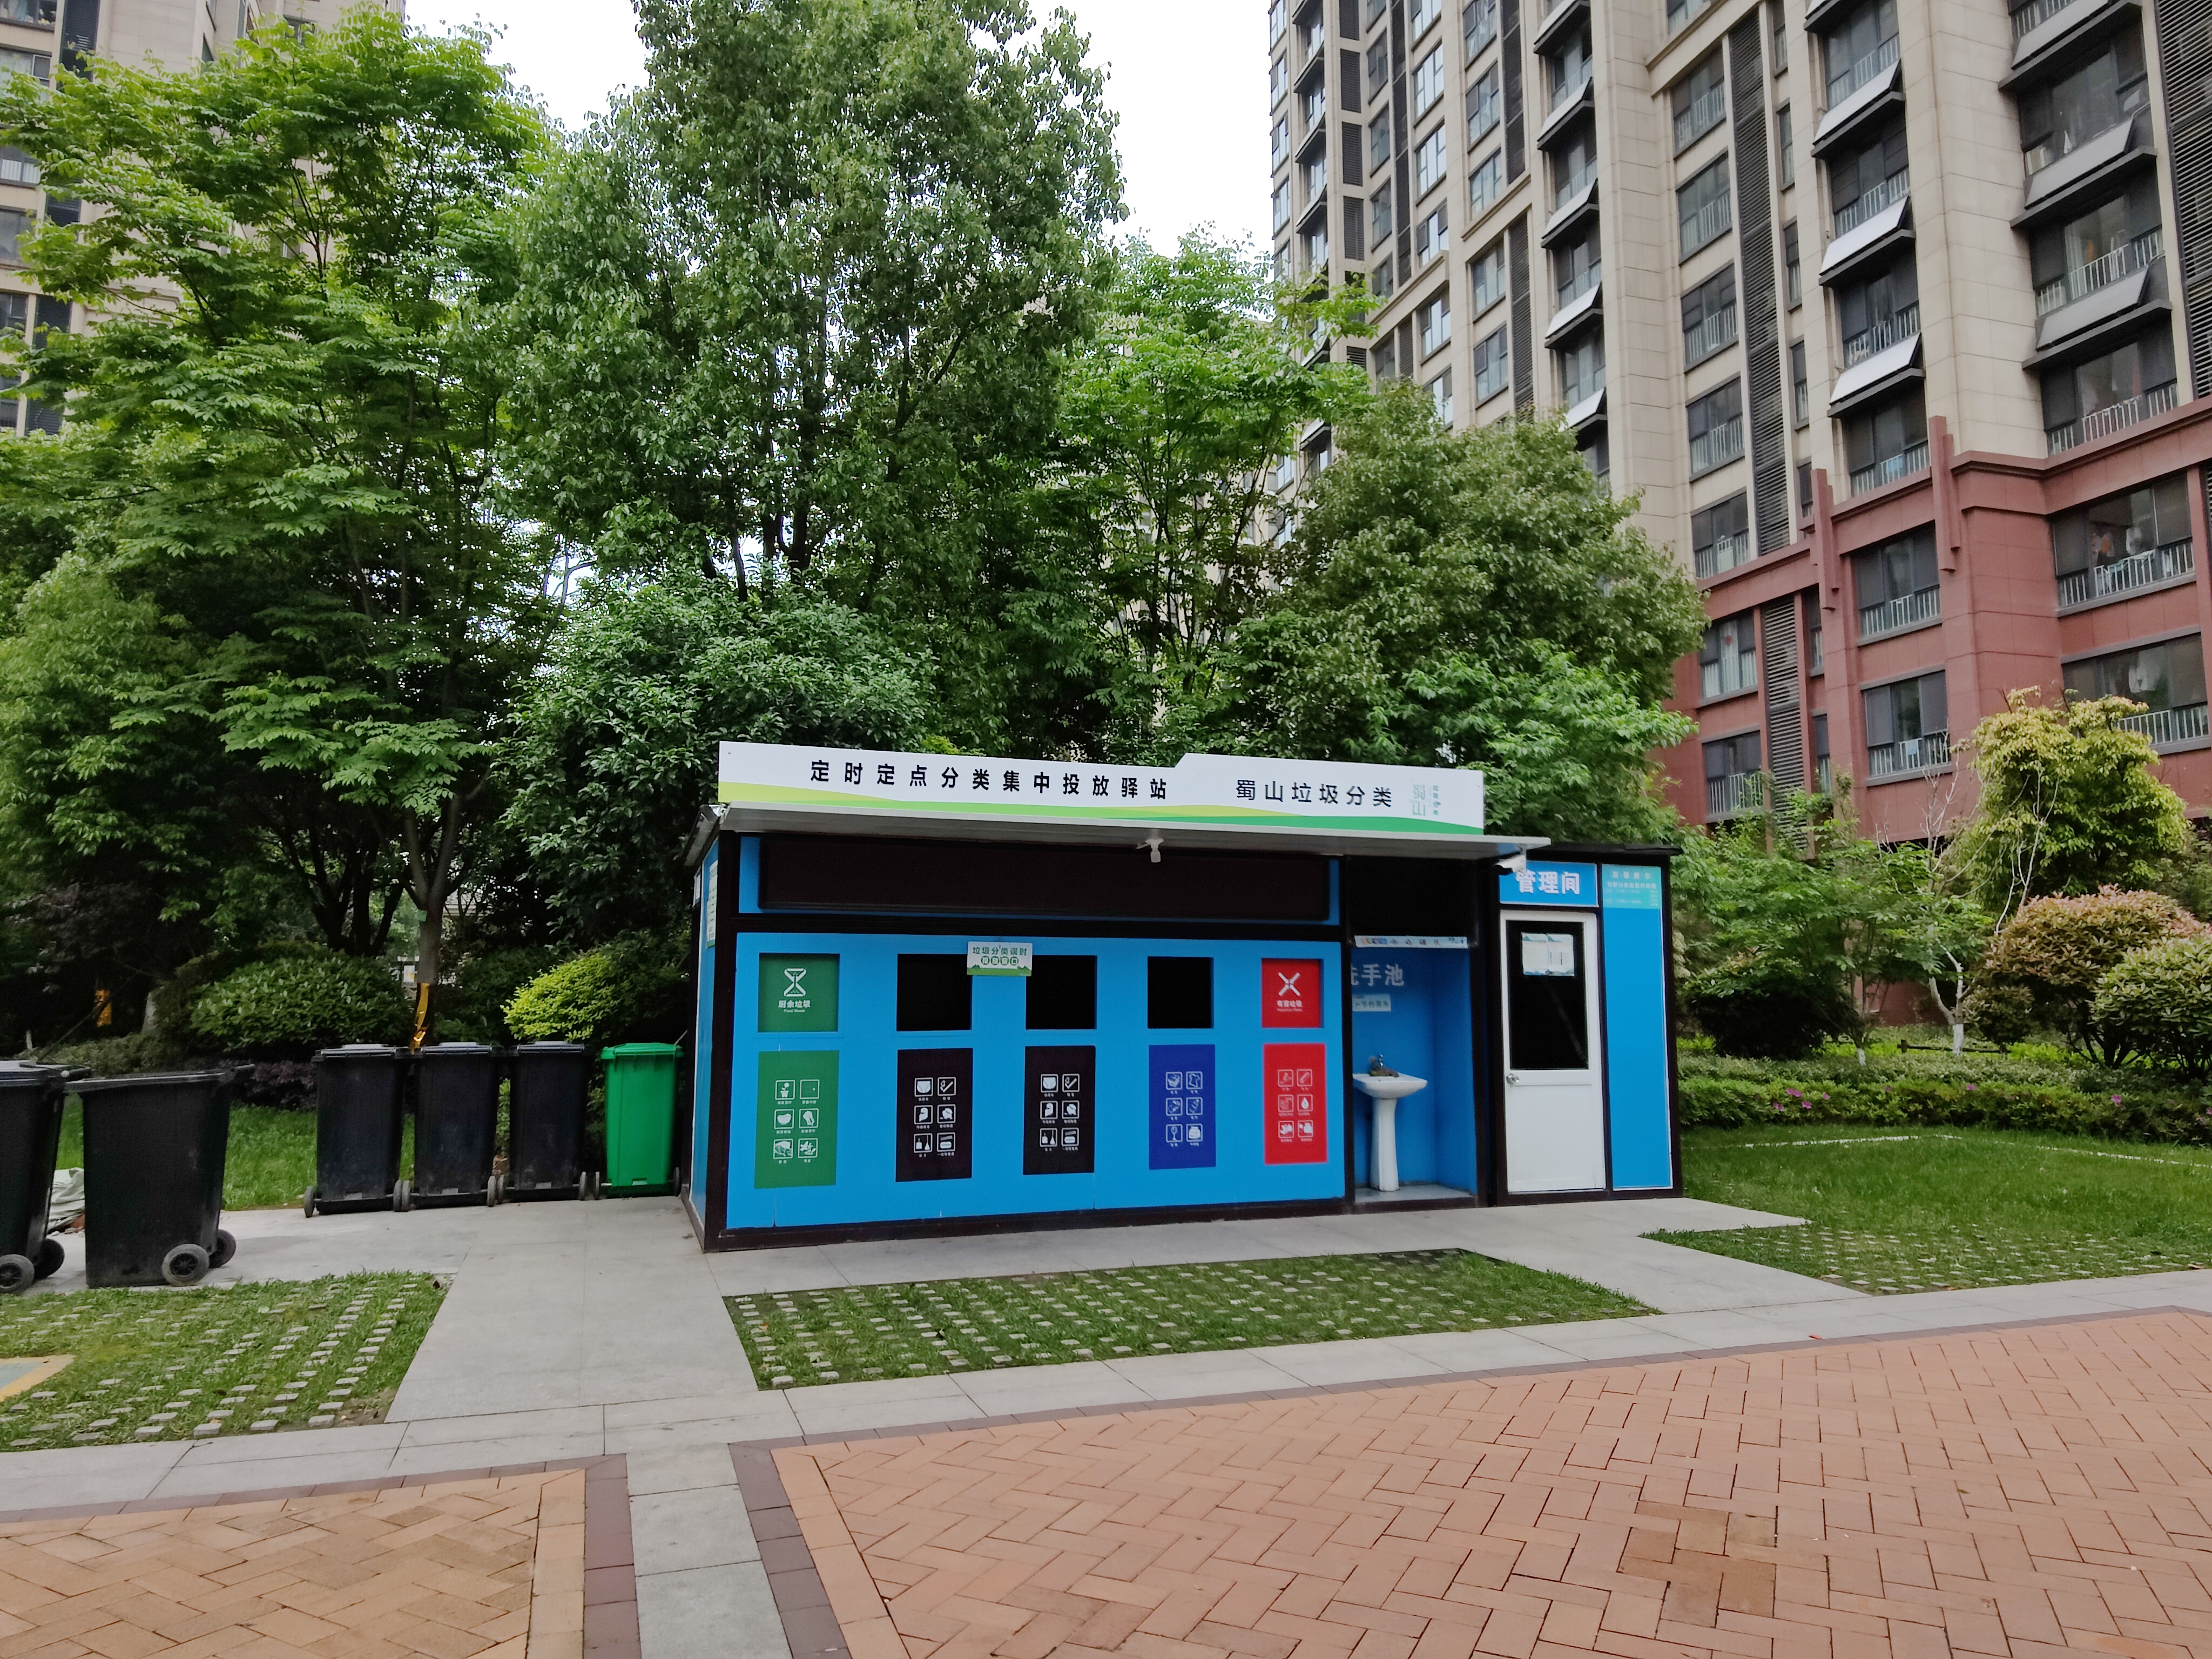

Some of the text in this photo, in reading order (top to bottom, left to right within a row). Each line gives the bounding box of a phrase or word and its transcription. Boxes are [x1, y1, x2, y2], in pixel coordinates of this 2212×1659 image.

[811, 760, 1167, 800] 定时定点分类集中投放驿站
[1236, 779, 1393, 807] 蜀山垃圾分类
[1516, 871, 1581, 895] 管理间
